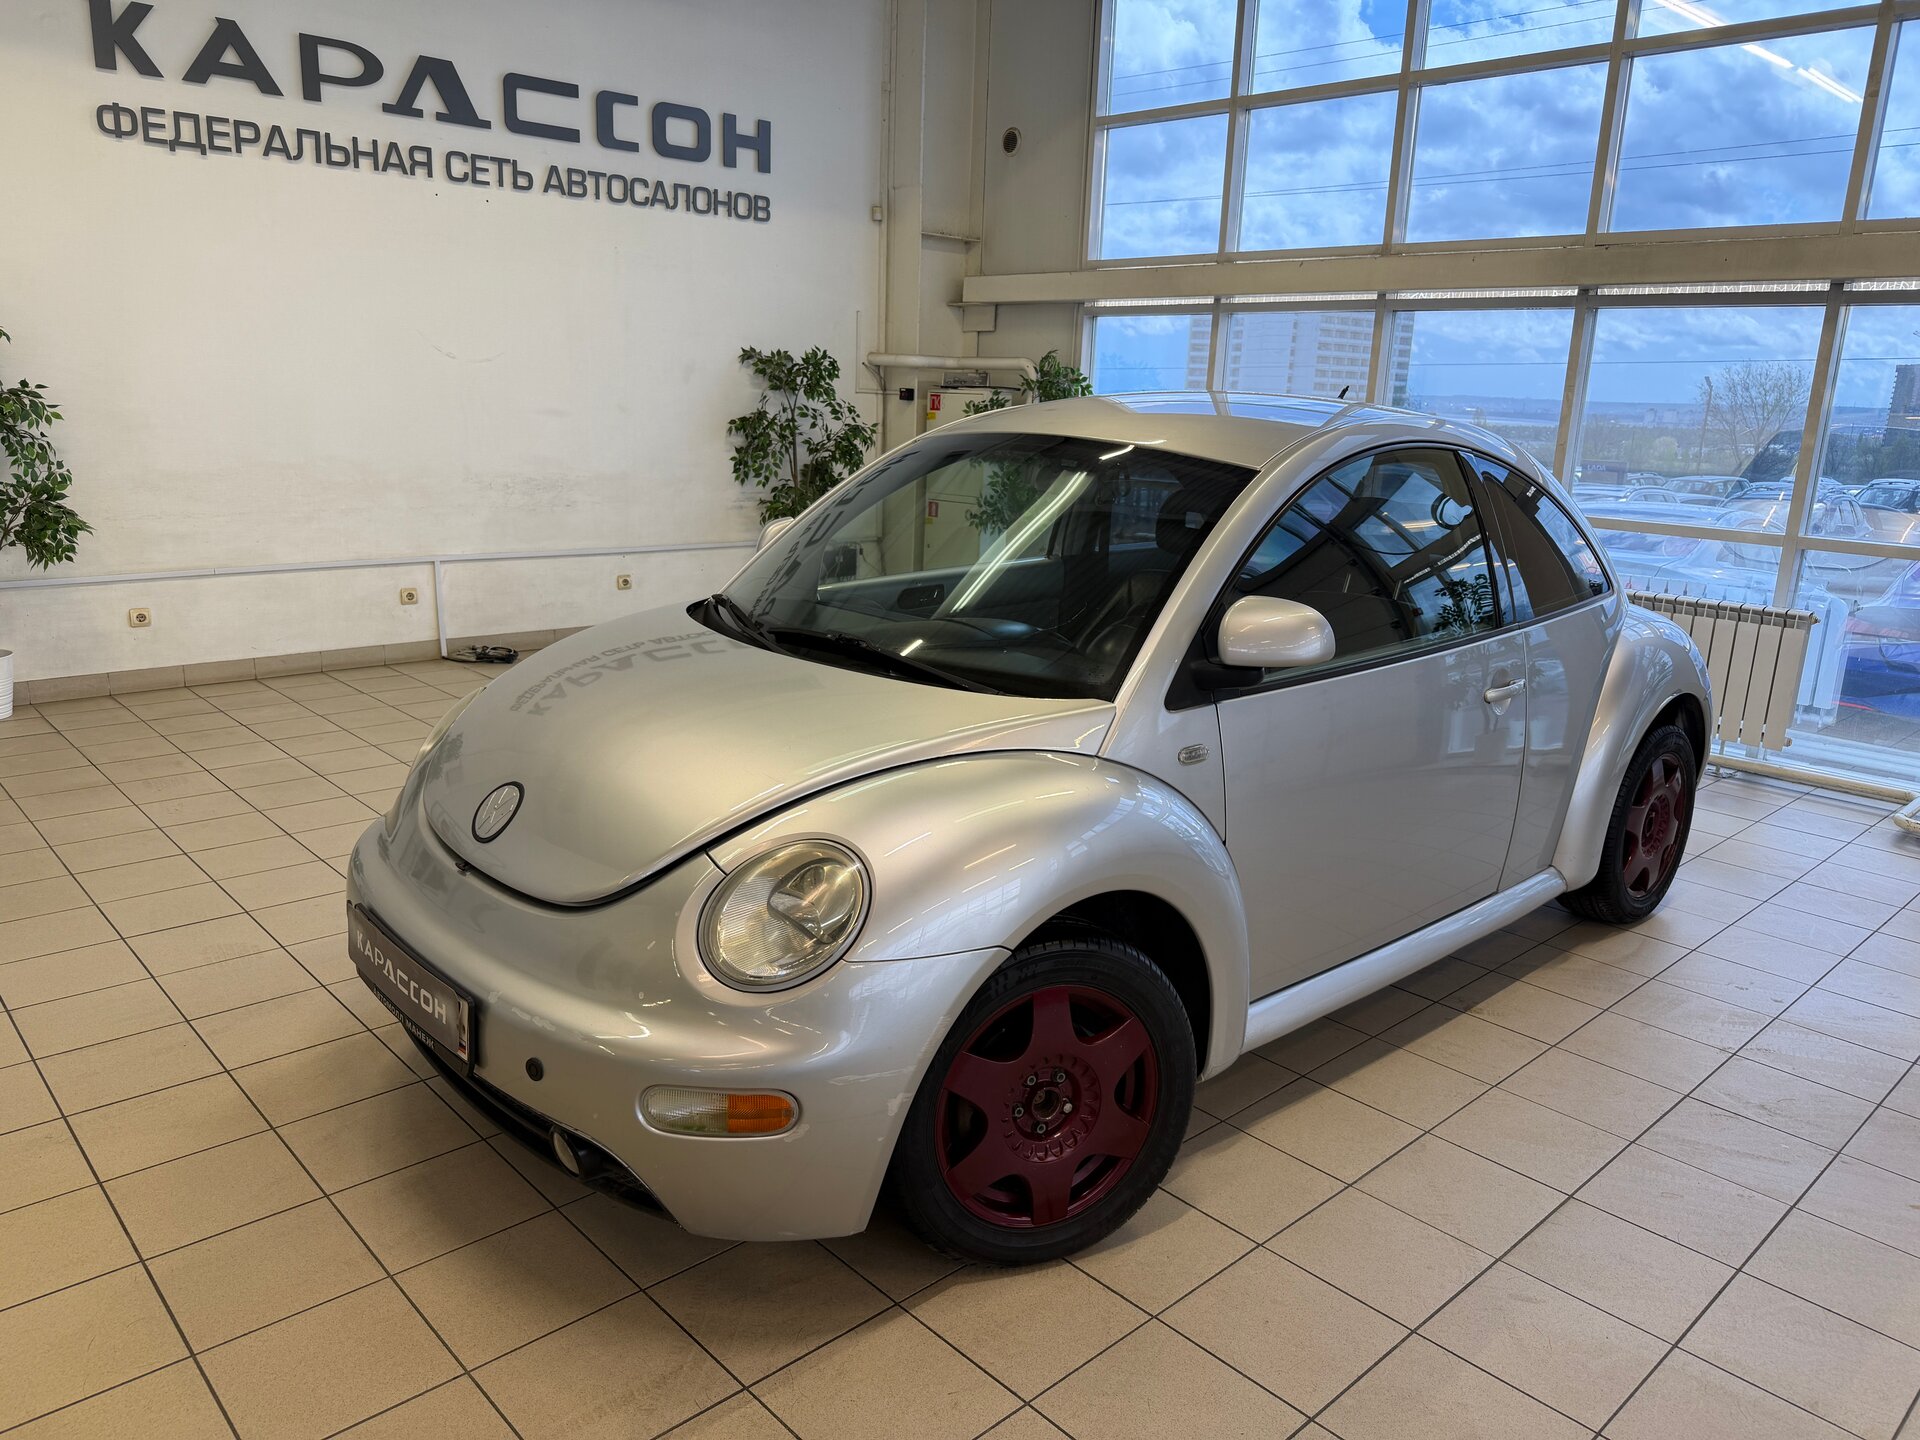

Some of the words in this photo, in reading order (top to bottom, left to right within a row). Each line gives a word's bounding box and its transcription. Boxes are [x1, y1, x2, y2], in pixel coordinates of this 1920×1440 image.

[88, 0, 772, 174] КАРАССОН
[96, 102, 433, 179] ФЕДЕРАЛЬНАЯ
[446, 150, 534, 192] СЕТЬ
[543, 165, 772, 223] АВТОСАЛОНОВ
[356, 930, 447, 1025] КАРАССОН
